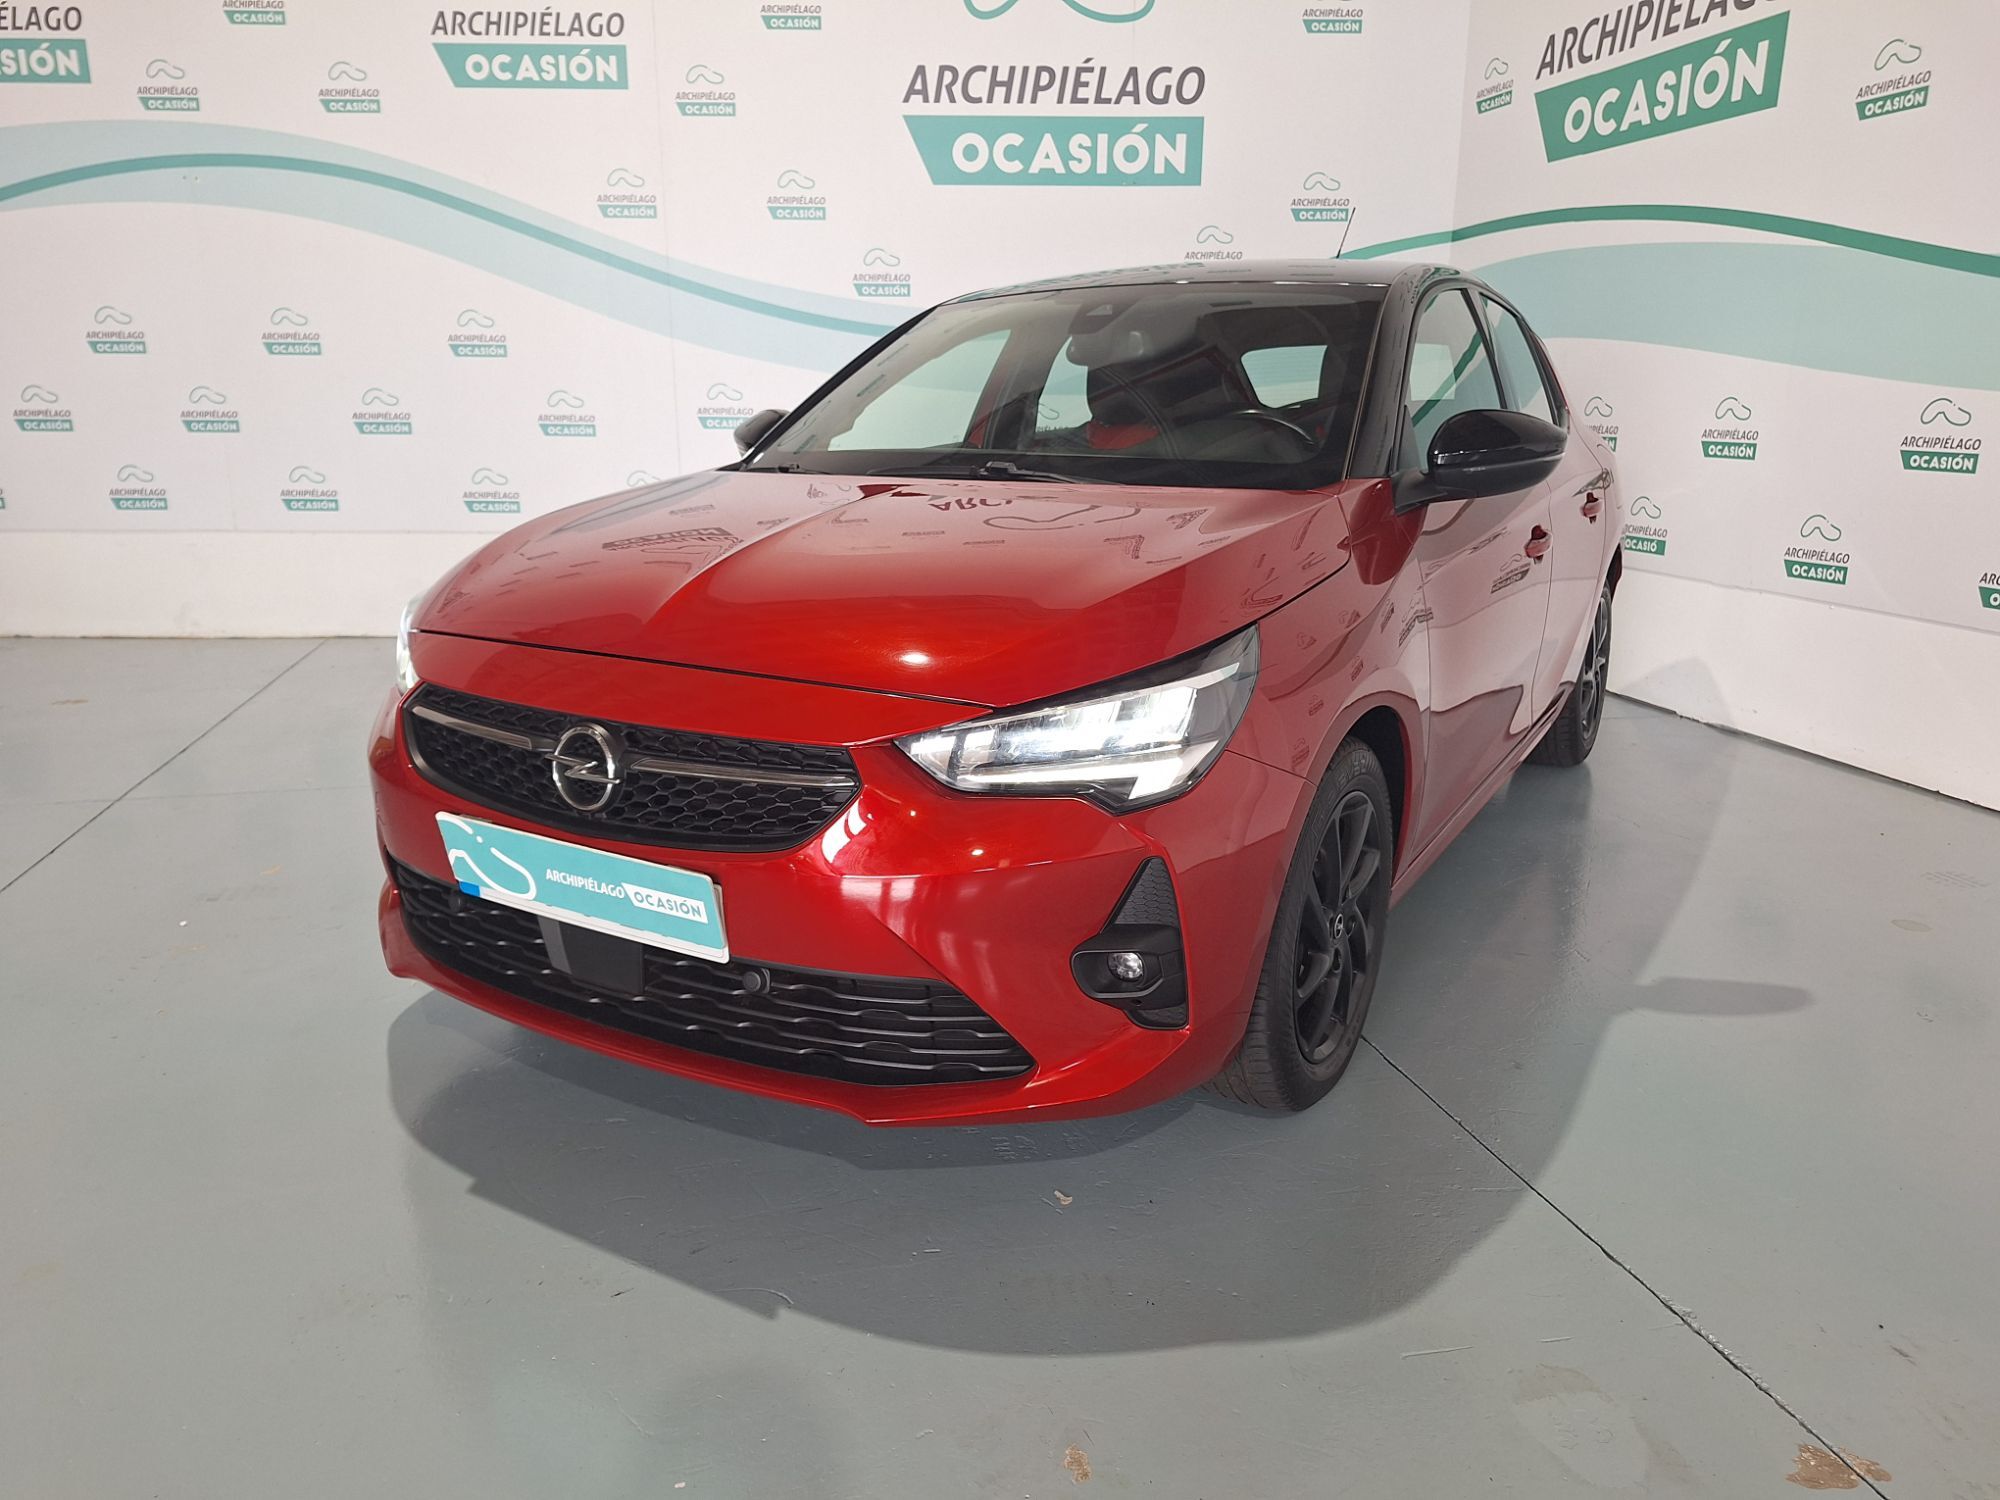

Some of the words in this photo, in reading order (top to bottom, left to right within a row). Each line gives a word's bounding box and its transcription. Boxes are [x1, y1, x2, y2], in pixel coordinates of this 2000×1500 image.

[760, 3, 821, 14] ARCHIPIÉLAGO
[1302, 7, 1363, 18] ARCHIPIÉLAGO
[233, 12, 282, 23] OCASIÓN
[430, 6, 625, 38] ARCHIPIÉLAGO
[770, 16, 819, 29] OCASIÓN
[1311, 21, 1360, 32] OCASIÓN
[0, 42, 80, 76] SIÓN
[464, 48, 618, 83] OCASIÓN
[903, 57, 1205, 105] ARCHIPIÉLAGO
[1856, 70, 1932, 100] ARCHIPIÉLAGO
[137, 85, 198, 96] ARCHIPIÉLAGO
[318, 87, 379, 98] ARCHIPIÉLAGO
[1476, 79, 1514, 99] ARCHIPIÉLAGO
[1563, 37, 1770, 144] OCASIÓN
[675, 90, 736, 100] ARCHIPIÉLAGO
[148, 99, 197, 110] OCASIÓN
[329, 101, 379, 111] OCASIÓN
[1479, 92, 1512, 111] OCASIÓN
[1864, 90, 1925, 117] OCASIÓN
[685, 104, 733, 115] OCASIÓN
[951, 124, 1187, 174] OCASIÓN
[597, 193, 656, 203] ARCHIPIÉLAGO
[767, 194, 826, 205] ARCHIPIÉLAGO
[1291, 196, 1350, 207] ARCHIPIÉLAGO
[607, 206, 654, 217] OCASIÓN
[776, 207, 824, 219] OCASIÓN
[1299, 209, 1348, 221] OCASIÓN
[1184, 250, 1243, 260] ARCHIPIÉLAGO
[853, 273, 911, 283] ARCHIPIÉLAGO
[862, 285, 910, 296] OCASIÓN
[86, 330, 145, 340] ARCHIPIÉLAGO
[261, 331, 320, 341] ARCHIPIÉLAGO
[447, 333, 506, 343] ARCHIPIÉLAGO
[96, 342, 145, 353] OCASIÓN
[271, 343, 320, 354] OCASIÓN
[457, 345, 506, 356] OCASIÓN
[13, 408, 71, 418] ARCHIPIÉLAGO
[180, 409, 238, 419] ARCHIPIÉLAGO
[352, 411, 411, 421] ARCHIPIÉLAGO
[697, 407, 754, 416] ARCHIPIÉLAGO
[538, 414, 595, 423] ARCHIPIÉLAGO
[23, 420, 71, 430] OCASIÓN
[190, 421, 238, 432] OCASIÓN
[362, 423, 410, 434] OCASIÓN
[547, 425, 595, 436] OCASIÓN
[1701, 428, 1759, 441] ARCHIPIÉLAGO
[1901, 436, 1981, 451] ARCHIPIÉLAGO
[1707, 443, 1755, 459] OCASIÓN
[1909, 452, 1974, 472] OCASIÓN
[109, 487, 166, 497] ARCHIPIÉLAGO
[280, 488, 337, 498] ARCHIPIÉLAGO
[462, 490, 520, 500] ARCHIPIÉLAGO
[119, 499, 167, 509] OCASIÓN
[290, 500, 338, 510] OCASIÓN
[472, 502, 520, 512] OCASIÓN
[1784, 546, 1850, 565] ARCHIPIÉLAGO
[1792, 563, 1844, 583] OCASIÓN
[545, 869, 625, 899] ARCHIPIÉLAGO
[634, 887, 702, 918] OCASIÓN
